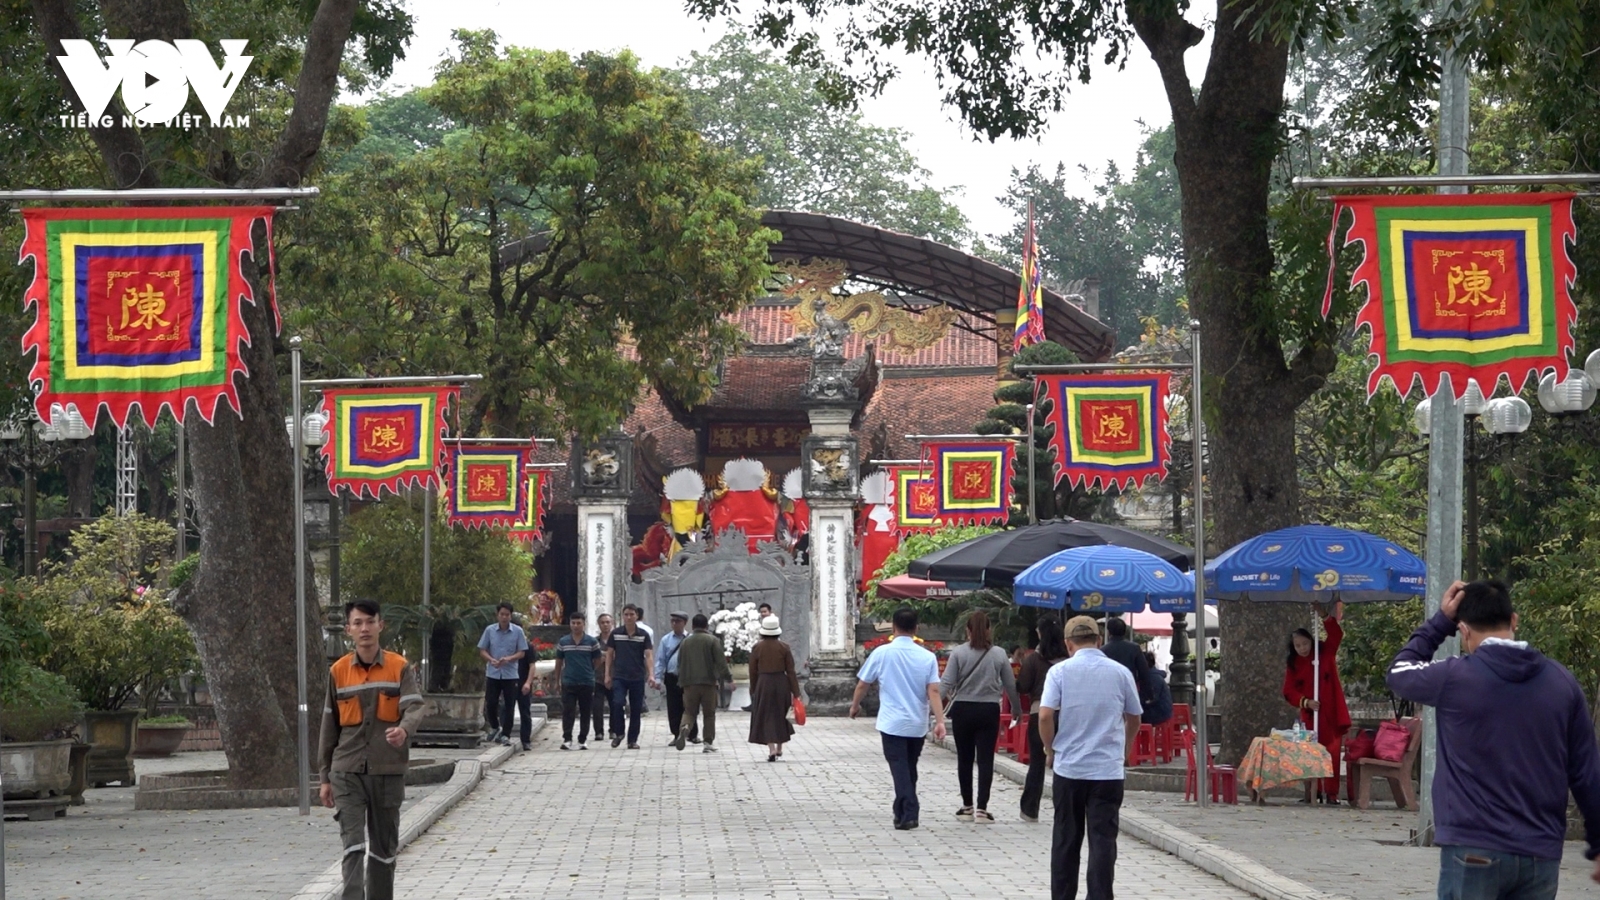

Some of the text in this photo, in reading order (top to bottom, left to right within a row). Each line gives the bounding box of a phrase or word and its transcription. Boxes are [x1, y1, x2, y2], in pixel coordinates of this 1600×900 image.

[1447, 262, 1497, 306] 陳
[120, 284, 171, 330] 陳
[371, 424, 399, 448] 陳
[1100, 413, 1127, 437] 陳
[476, 474, 497, 493] 陳
[964, 471, 981, 488] 陳
